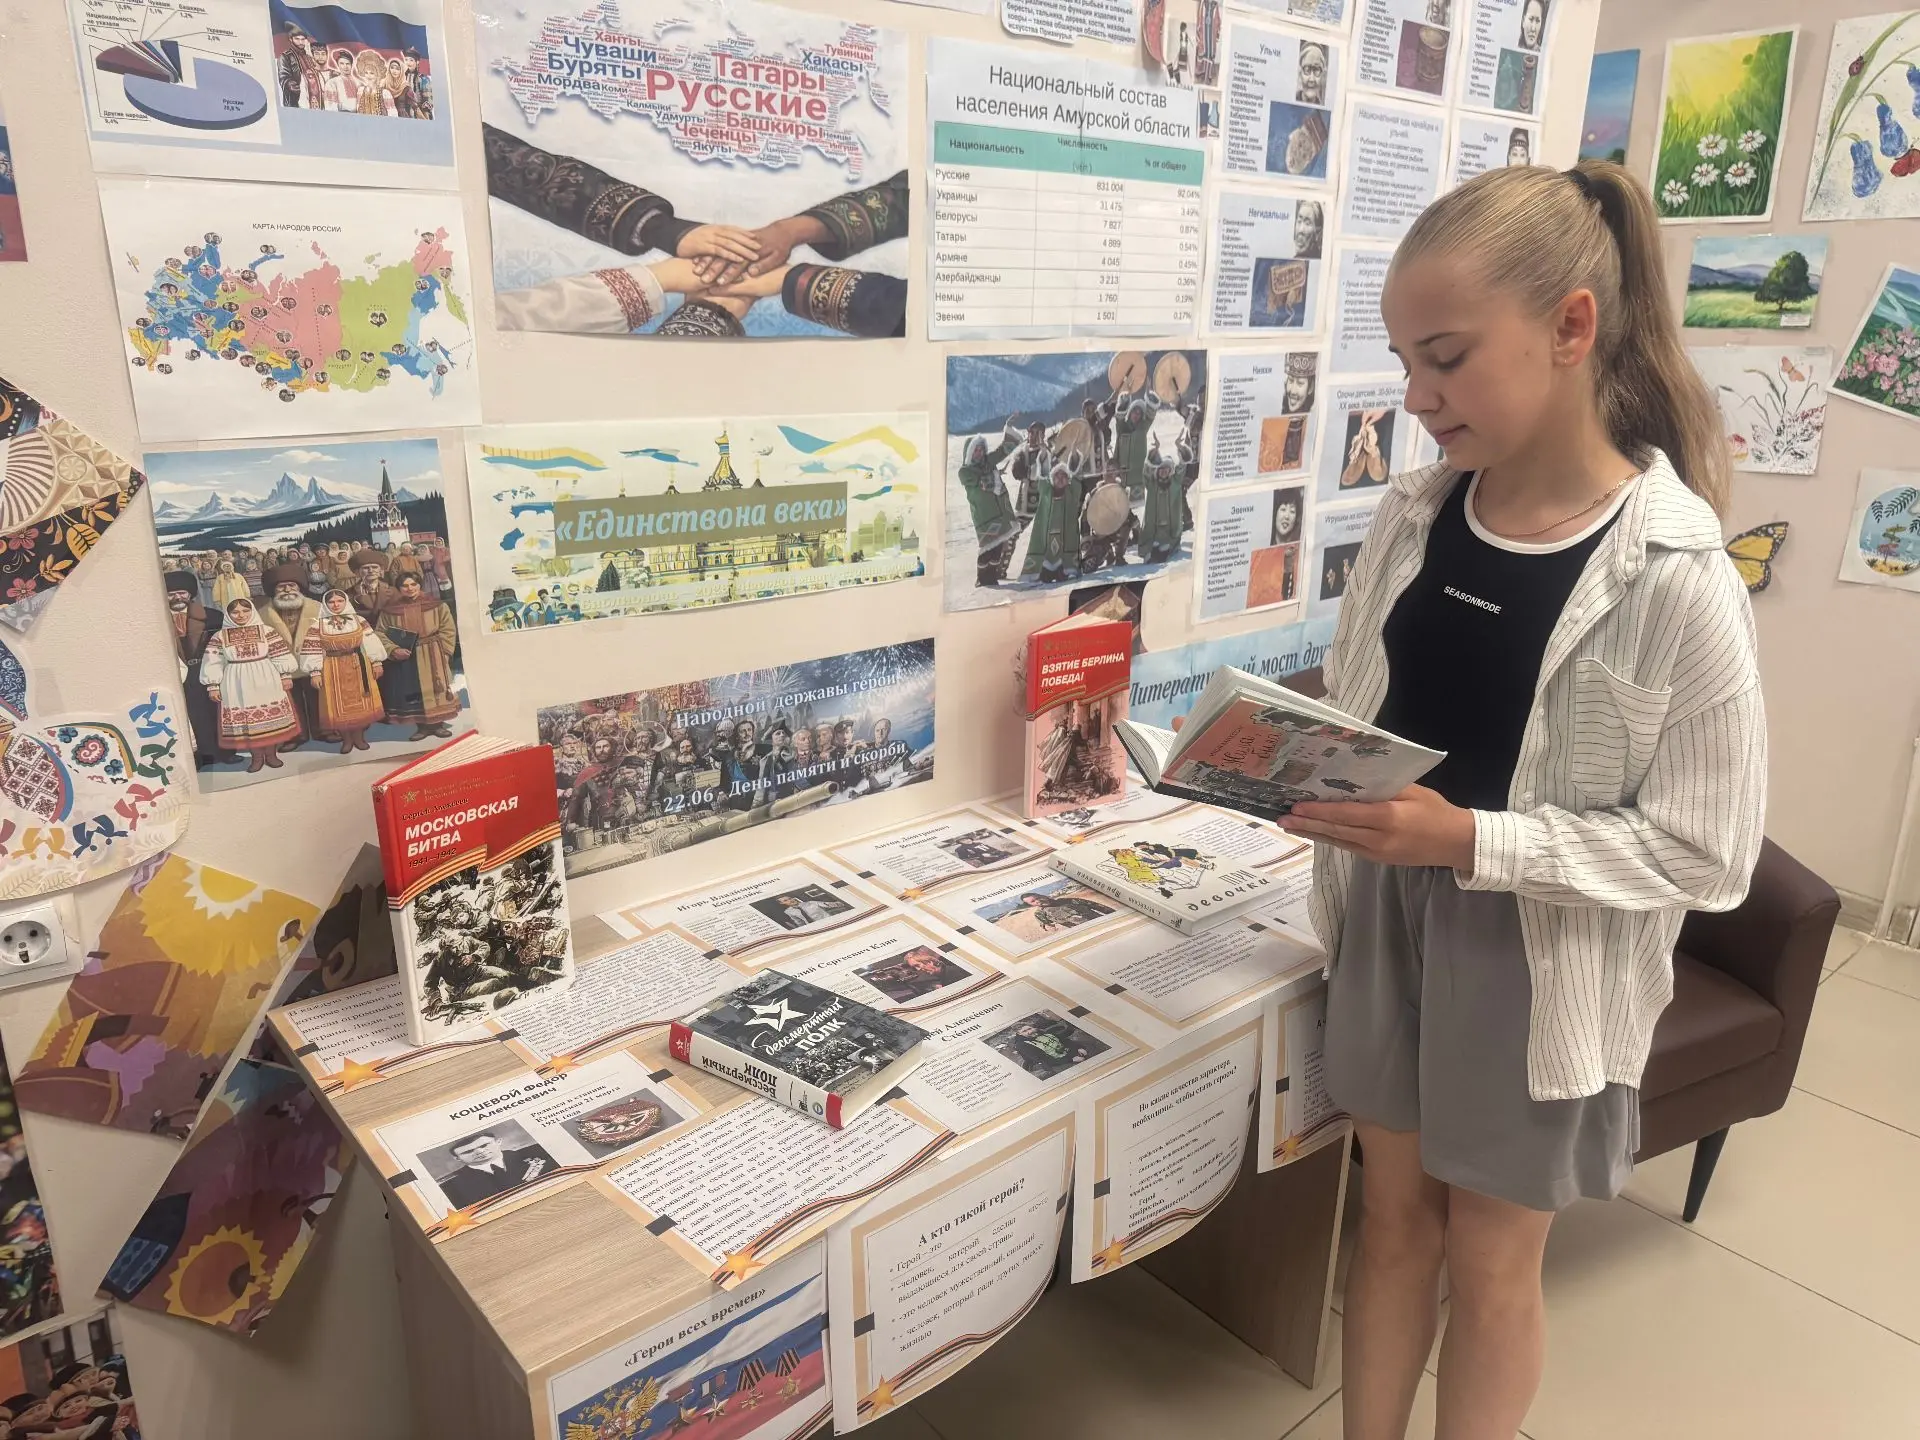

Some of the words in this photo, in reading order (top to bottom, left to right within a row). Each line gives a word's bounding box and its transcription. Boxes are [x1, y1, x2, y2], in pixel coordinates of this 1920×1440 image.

[594, 31, 641, 46] Ханты
[232, 50, 252, 58] Татары
[563, 35, 657, 63] Чуваши
[824, 43, 873, 61] Тувинцы
[1259, 43, 1281, 58] Ульчи
[547, 53, 641, 79] Буряты
[802, 50, 863, 73] Хакасы
[711, 52, 825, 92] Татары
[537, 73, 601, 91] Мордва
[601, 83, 628, 93] Коми
[989, 64, 1115, 101] Национальный
[1119, 87, 1168, 109] состав
[646, 68, 827, 121] Русские
[103, 110, 124, 118] Другие
[627, 100, 672, 111] Калмыки
[655, 110, 706, 124] Удмурты
[726, 111, 824, 140] Башкиры
[955, 95, 1048, 120] населения
[1053, 104, 1130, 132] Амурской
[1134, 115, 1190, 139] области
[675, 122, 757, 144] Чеченцы
[692, 141, 732, 154] Якуты
[949, 138, 1025, 155] Национальность
[1057, 136, 1108, 152] Численность
[935, 169, 970, 181] Русские
[1161, 160, 1187, 172] общего
[1096, 181, 1110, 192] 831
[936, 190, 978, 203] Украинцы
[1100, 201, 1108, 211] 31
[1109, 202, 1122, 212] 475
[935, 211, 978, 223] Белорусы
[1103, 220, 1108, 229] 7
[252, 222, 275, 231] КАРТА
[276, 223, 311, 232] НАРОДОВ
[312, 224, 342, 233] РОССИИ
[935, 231, 967, 242] Татары
[1102, 238, 1108, 247] 4
[935, 252, 968, 263] Армяне
[1101, 256, 1107, 266] 4
[1107, 257, 1120, 267] 045
[935, 272, 1001, 283] Азербайджанцы
[1099, 276, 1105, 284] 3
[1106, 276, 1119, 285] 213
[935, 292, 964, 303] Немцы
[1099, 293, 1103, 302] 1
[1104, 293, 1118, 303] 760
[935, 312, 965, 322] Эвенки
[1097, 312, 1101, 321] 1
[1102, 312, 1115, 321] 501
[774, 497, 847, 523] века»
[1230, 505, 1254, 516] Эвенки
[1443, 585, 1502, 615] SEASONMODE
[1041, 658, 1081, 676] ВЗЯТИЕ
[1081, 651, 1125, 668] БЕРЛИНА
[1257, 650, 1299, 676] мост
[1041, 672, 1085, 688] ПОБЕДА!
[675, 700, 766, 729] Народной
[774, 680, 849, 710] державы
[852, 673, 897, 696] герои
[663, 787, 714, 813] 22.06
[728, 775, 773, 798] День
[776, 757, 837, 786] памяти
[840, 754, 850, 768] и
[853, 740, 907, 770] скорби
[402, 808, 431, 821] Сергей
[433, 798, 469, 812] Алексеев
[405, 796, 519, 840] МОСКОВСКАЯ
[407, 830, 462, 857] БИТВА
[676, 899, 709, 913] Игорь
[710, 877, 781, 903] Владимирович
[970, 887, 1006, 904] Евгений
[1006, 872, 1054, 892] Поддубный
[818, 943, 871, 970] Сергеевич
[296, 1008, 340, 1025] которые
[302, 1020, 339, 1034] внесли
[317, 1037, 356, 1052] многие
[337, 1044, 369, 1057] благо
[701, 1055, 777, 1099] Бессмертный
[449, 1088, 521, 1121] КОШЕВОЙ
[523, 1072, 568, 1092] Федор
[530, 1102, 567, 1119] Родился
[573, 1084, 607, 1100] станице
[595, 1086, 621, 1099] марта
[1139, 1103, 1149, 1112] Но
[1170, 1076, 1199, 1096] качества
[478, 1086, 557, 1121] Алексеевич
[541, 1118, 561, 1128] 1921
[561, 1109, 582, 1120] года
[644, 1146, 701, 1178] нравственного
[918, 1233, 927, 1248] А
[930, 1222, 951, 1240] кто
[953, 1199, 986, 1226] такой
[989, 1177, 1026, 1207] герой?
[697, 1210, 756, 1247] ответственный
[896, 1252, 921, 1272] Герой
[930, 1242, 942, 1254] это
[947, 1237, 980, 1262] который
[898, 1267, 949, 1304] выдающиеся
[950, 1261, 964, 1273] для
[965, 1247, 987, 1264] своей
[988, 1232, 1014, 1251] страны
[943, 1290, 975, 1315] который
[977, 1278, 994, 1297] ради
[996, 1262, 1020, 1282] других
[917, 1287, 948, 1309] человек
[624, 1336, 675, 1368] «Герои
[677, 1317, 708, 1340] всех
[711, 1287, 767, 1323] времен»
[899, 1329, 932, 1352] жизнью
